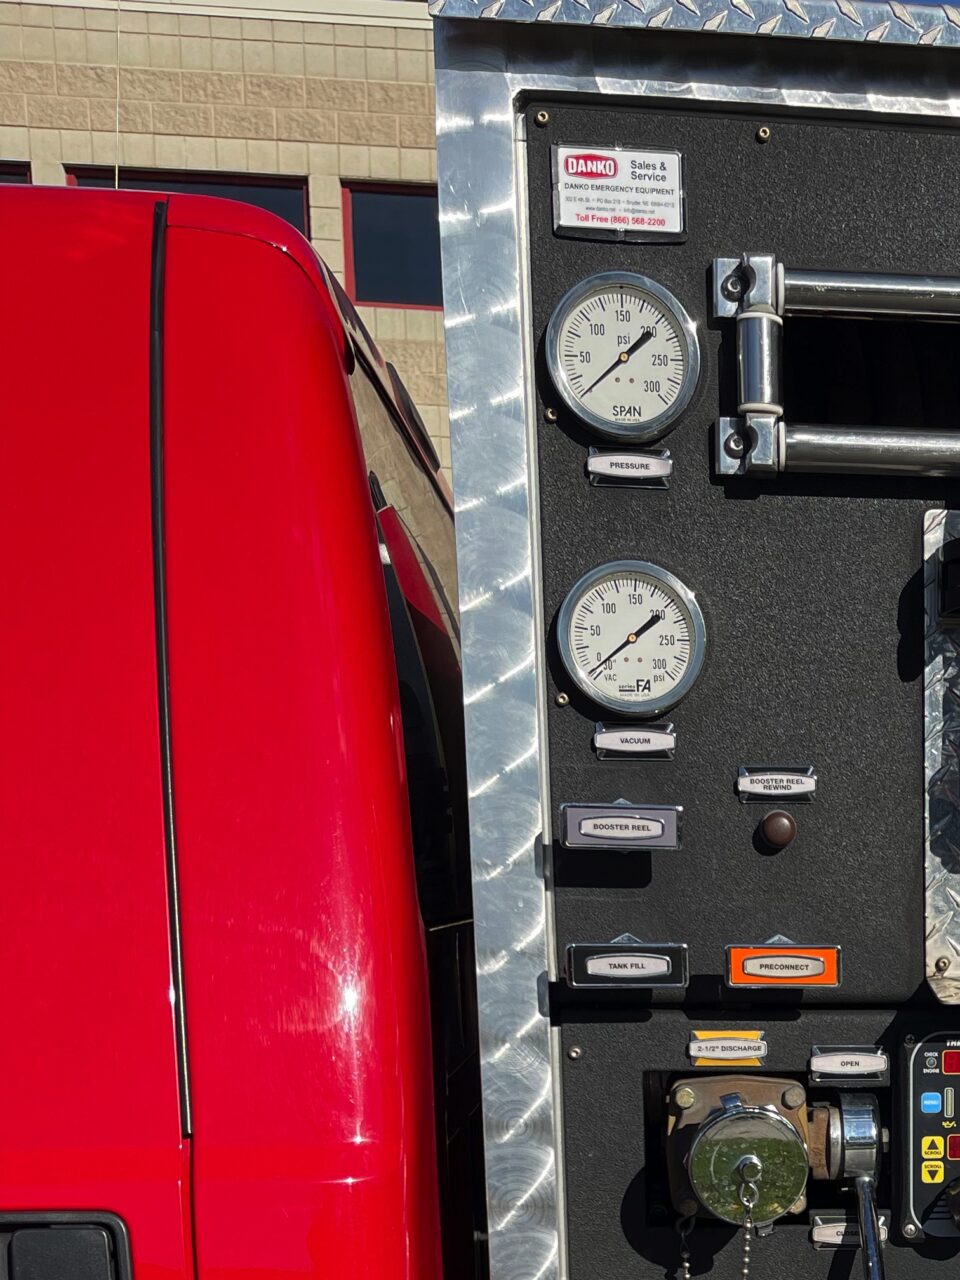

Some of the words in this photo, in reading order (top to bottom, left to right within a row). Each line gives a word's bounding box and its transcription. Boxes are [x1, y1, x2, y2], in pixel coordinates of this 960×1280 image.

[568, 158, 614, 175] DANKO
[631, 160, 656, 170] Sales
[660, 162, 666, 170] &
[631, 171, 666, 182] Service
[591, 184, 633, 193] EMERGENCY
[636, 185, 674, 195] EQUIPMENT
[576, 214, 589, 222] Toll
[592, 215, 608, 223] Free
[611, 216, 629, 225] (866)
[632, 217, 666, 226] 568-2200
[616, 310, 630, 322] 150
[589, 324, 605, 335] 100
[617, 333, 630, 347] psi
[580, 352, 590, 363] 50
[652, 355, 668, 366] 250
[644, 381, 660, 393] 300
[612, 406, 642, 417] SPAN
[610, 462, 650, 470] PRESSURE
[628, 594, 642, 605] 150
[602, 603, 616, 614] 100
[590, 625, 600, 636] 50
[659, 635, 675, 645] 250
[597, 652, 601, 661] 0
[652, 659, 667, 669] 300
[604, 674, 617, 682] VAC
[654, 674, 665, 683] psi
[636, 680, 651, 692] FA
